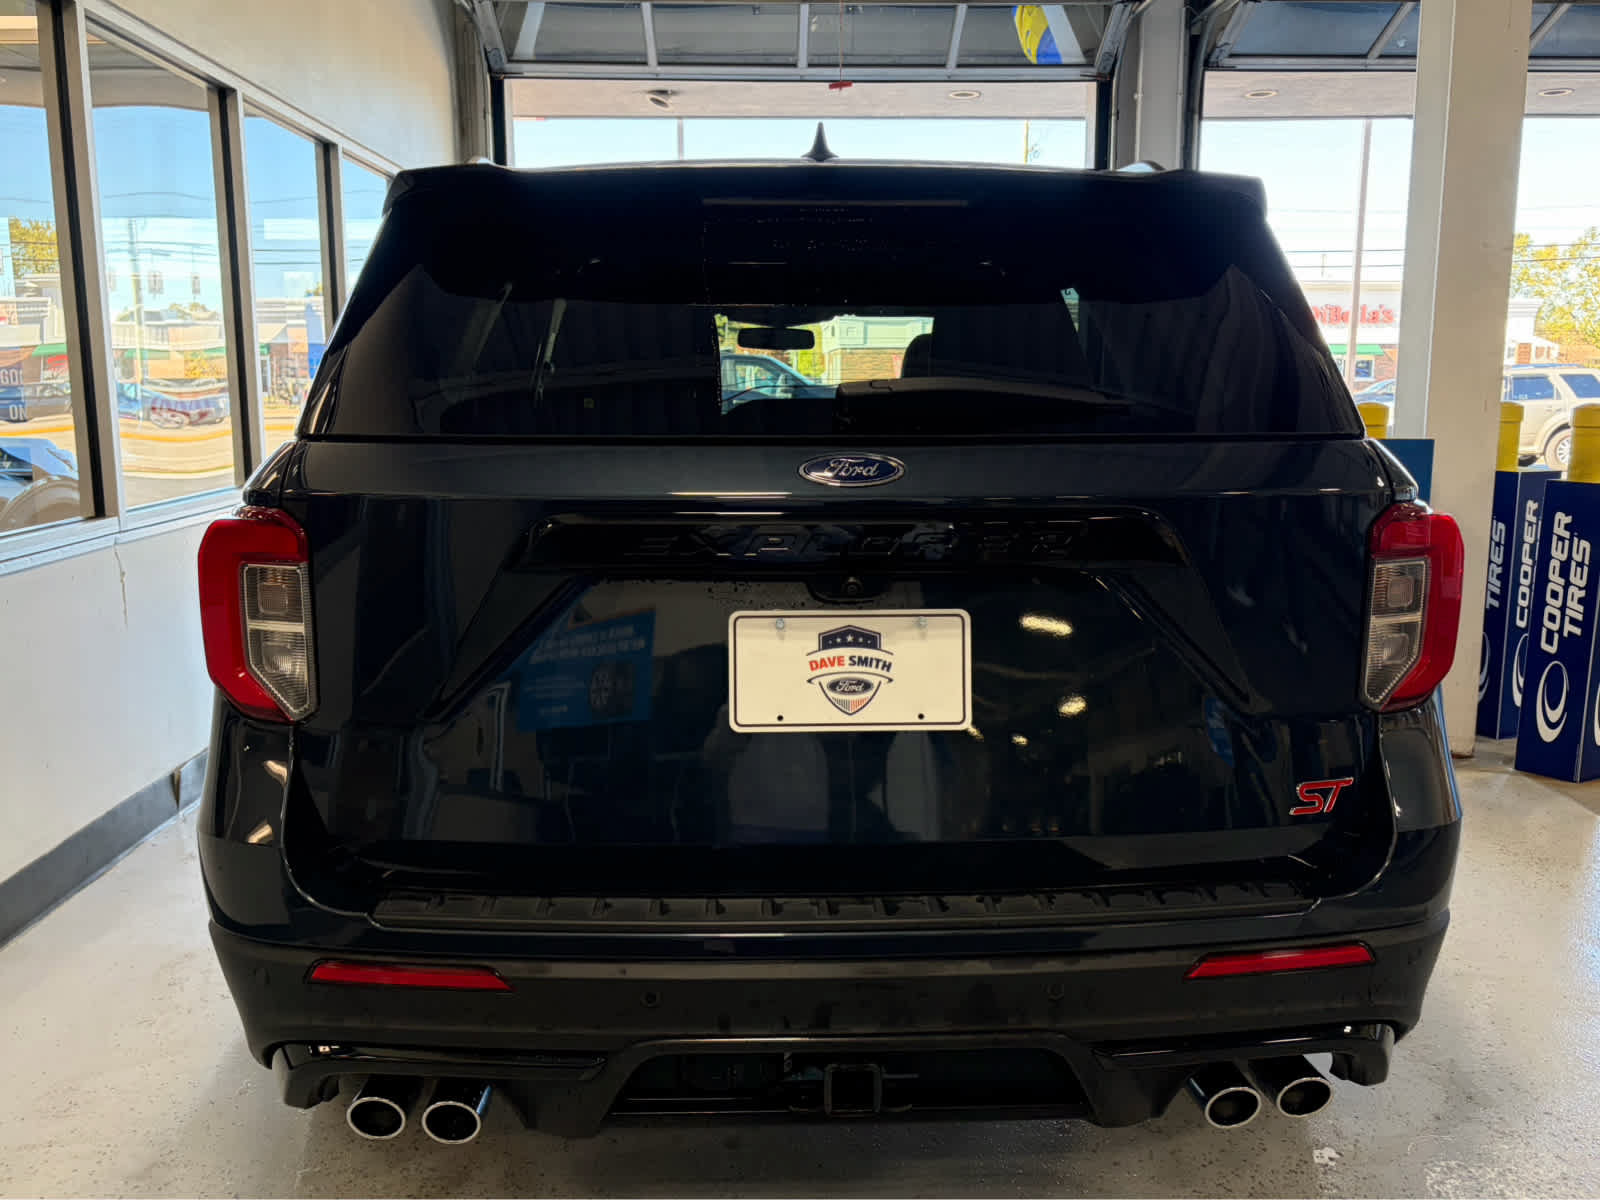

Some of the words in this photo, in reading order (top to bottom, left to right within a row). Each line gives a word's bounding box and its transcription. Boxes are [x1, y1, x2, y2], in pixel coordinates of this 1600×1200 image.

[1486, 519, 1506, 610] TIRES
[1516, 500, 1539, 629] COOPER
[1541, 511, 1573, 655] COOPER
[1563, 535, 1591, 638] TIRES
[809, 655, 846, 672] DAVE
[848, 655, 893, 673] SMITH
[836, 680, 865, 692] Ford
[1288, 776, 1354, 815] ST
